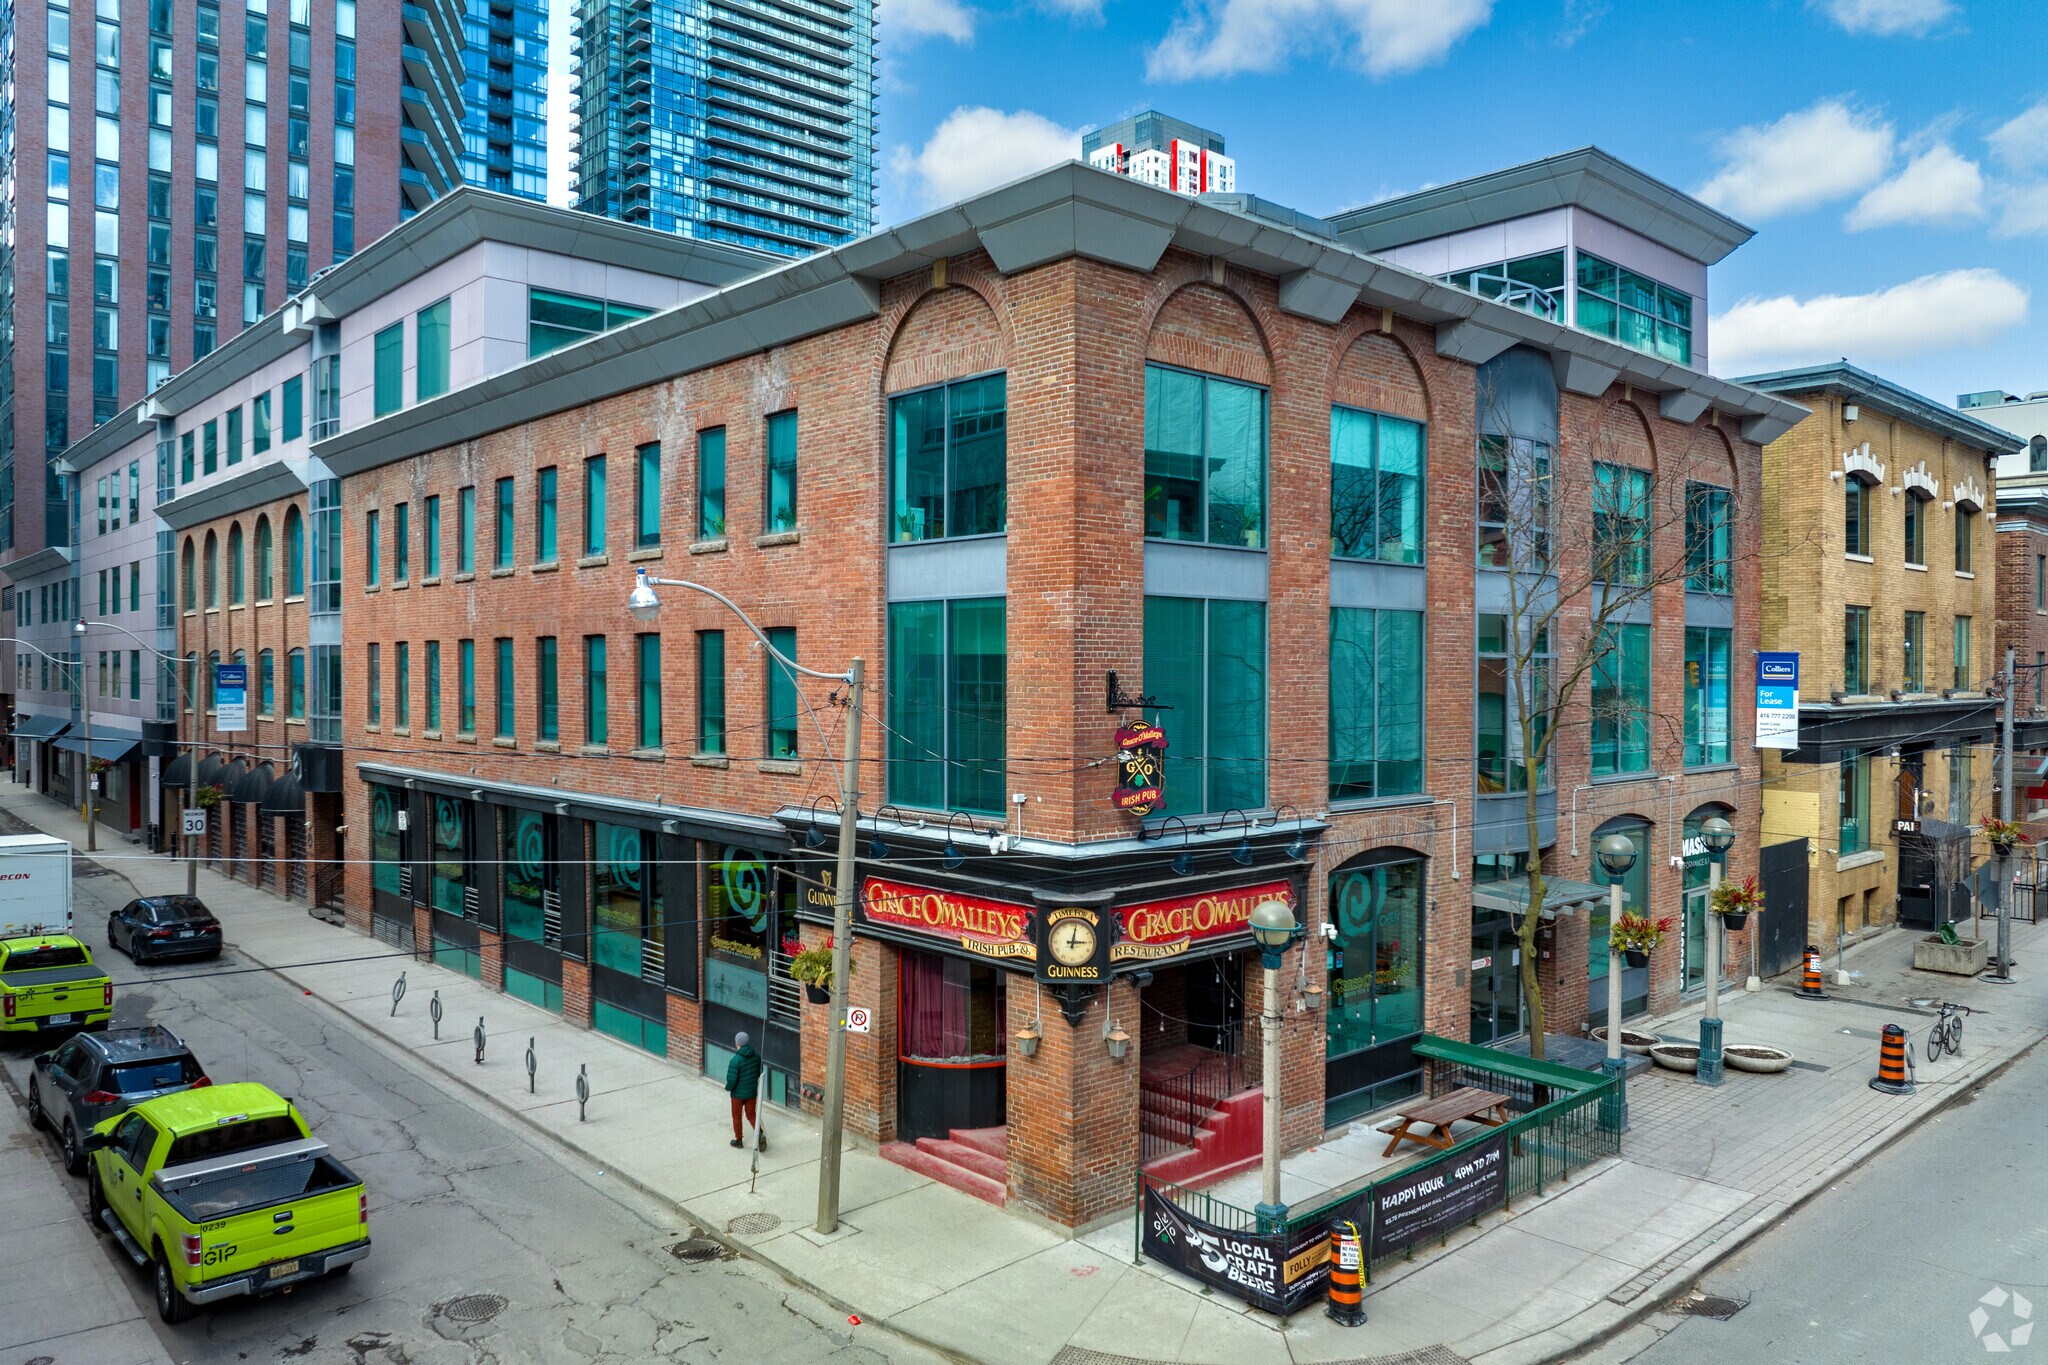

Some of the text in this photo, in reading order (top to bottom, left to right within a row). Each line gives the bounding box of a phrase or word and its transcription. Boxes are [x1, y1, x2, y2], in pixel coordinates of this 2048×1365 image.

[1122, 738, 1138, 746] Grace
[1126, 762, 1153, 775] G O
[1121, 790, 1157, 805] IRISH PUB
[185, 819, 204, 831] 30
[1897, 821, 1915, 831] PAI
[807, 888, 837, 908] GUINNE
[868, 883, 1022, 940] GRACE O'MALLEYS
[1054, 909, 1073, 919] TIME
[1074, 909, 1087, 917] FOR
[1128, 908, 1193, 942] GRACE
[968, 940, 994, 955] IRISH
[1115, 942, 1184, 958] RESTAURANT
[1047, 964, 1098, 978] GUINNESS
[1382, 1150, 1500, 1210] HAPPY HOUR 4PM TO 7PM
[1397, 1205, 1422, 1219] PREMIUM
[1421, 1201, 1432, 1211] BAR
[202, 1221, 226, 1232] 0239
[1153, 1220, 1176, 1236] G O
[204, 1245, 237, 1266] GIP
[1223, 1238, 1274, 1262] LOCAL
[1225, 1253, 1277, 1280] CRAFT
[1290, 1255, 1311, 1275] FOLLY
[1228, 1266, 1276, 1294] BEERS
